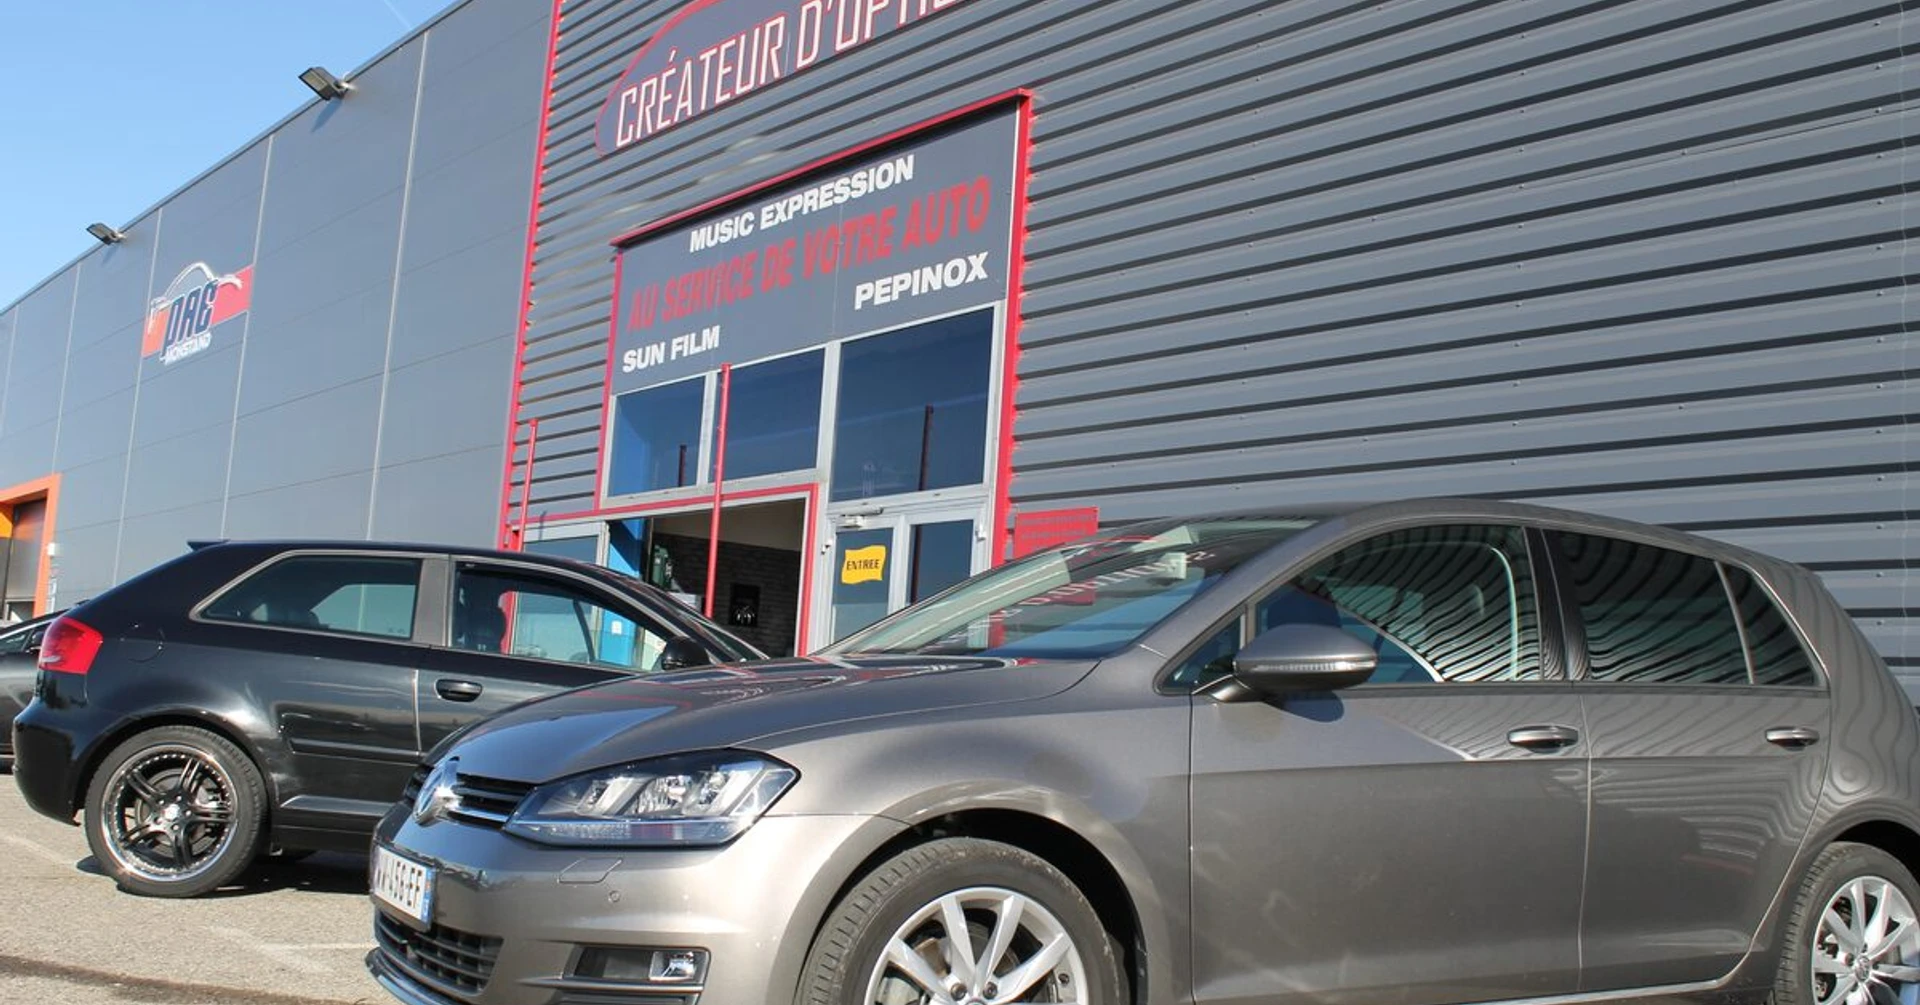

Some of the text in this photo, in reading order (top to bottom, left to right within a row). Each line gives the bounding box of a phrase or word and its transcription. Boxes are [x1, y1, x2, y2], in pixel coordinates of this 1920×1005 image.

[616, 16, 785, 147] CRÉATEUR
[690, 154, 914, 252] MUSIC EXPRESSION
[627, 175, 992, 332] AU SERVICE DE VOTRE AUTO
[854, 252, 989, 310] PEPINOX
[622, 325, 720, 373] SUN FILM
